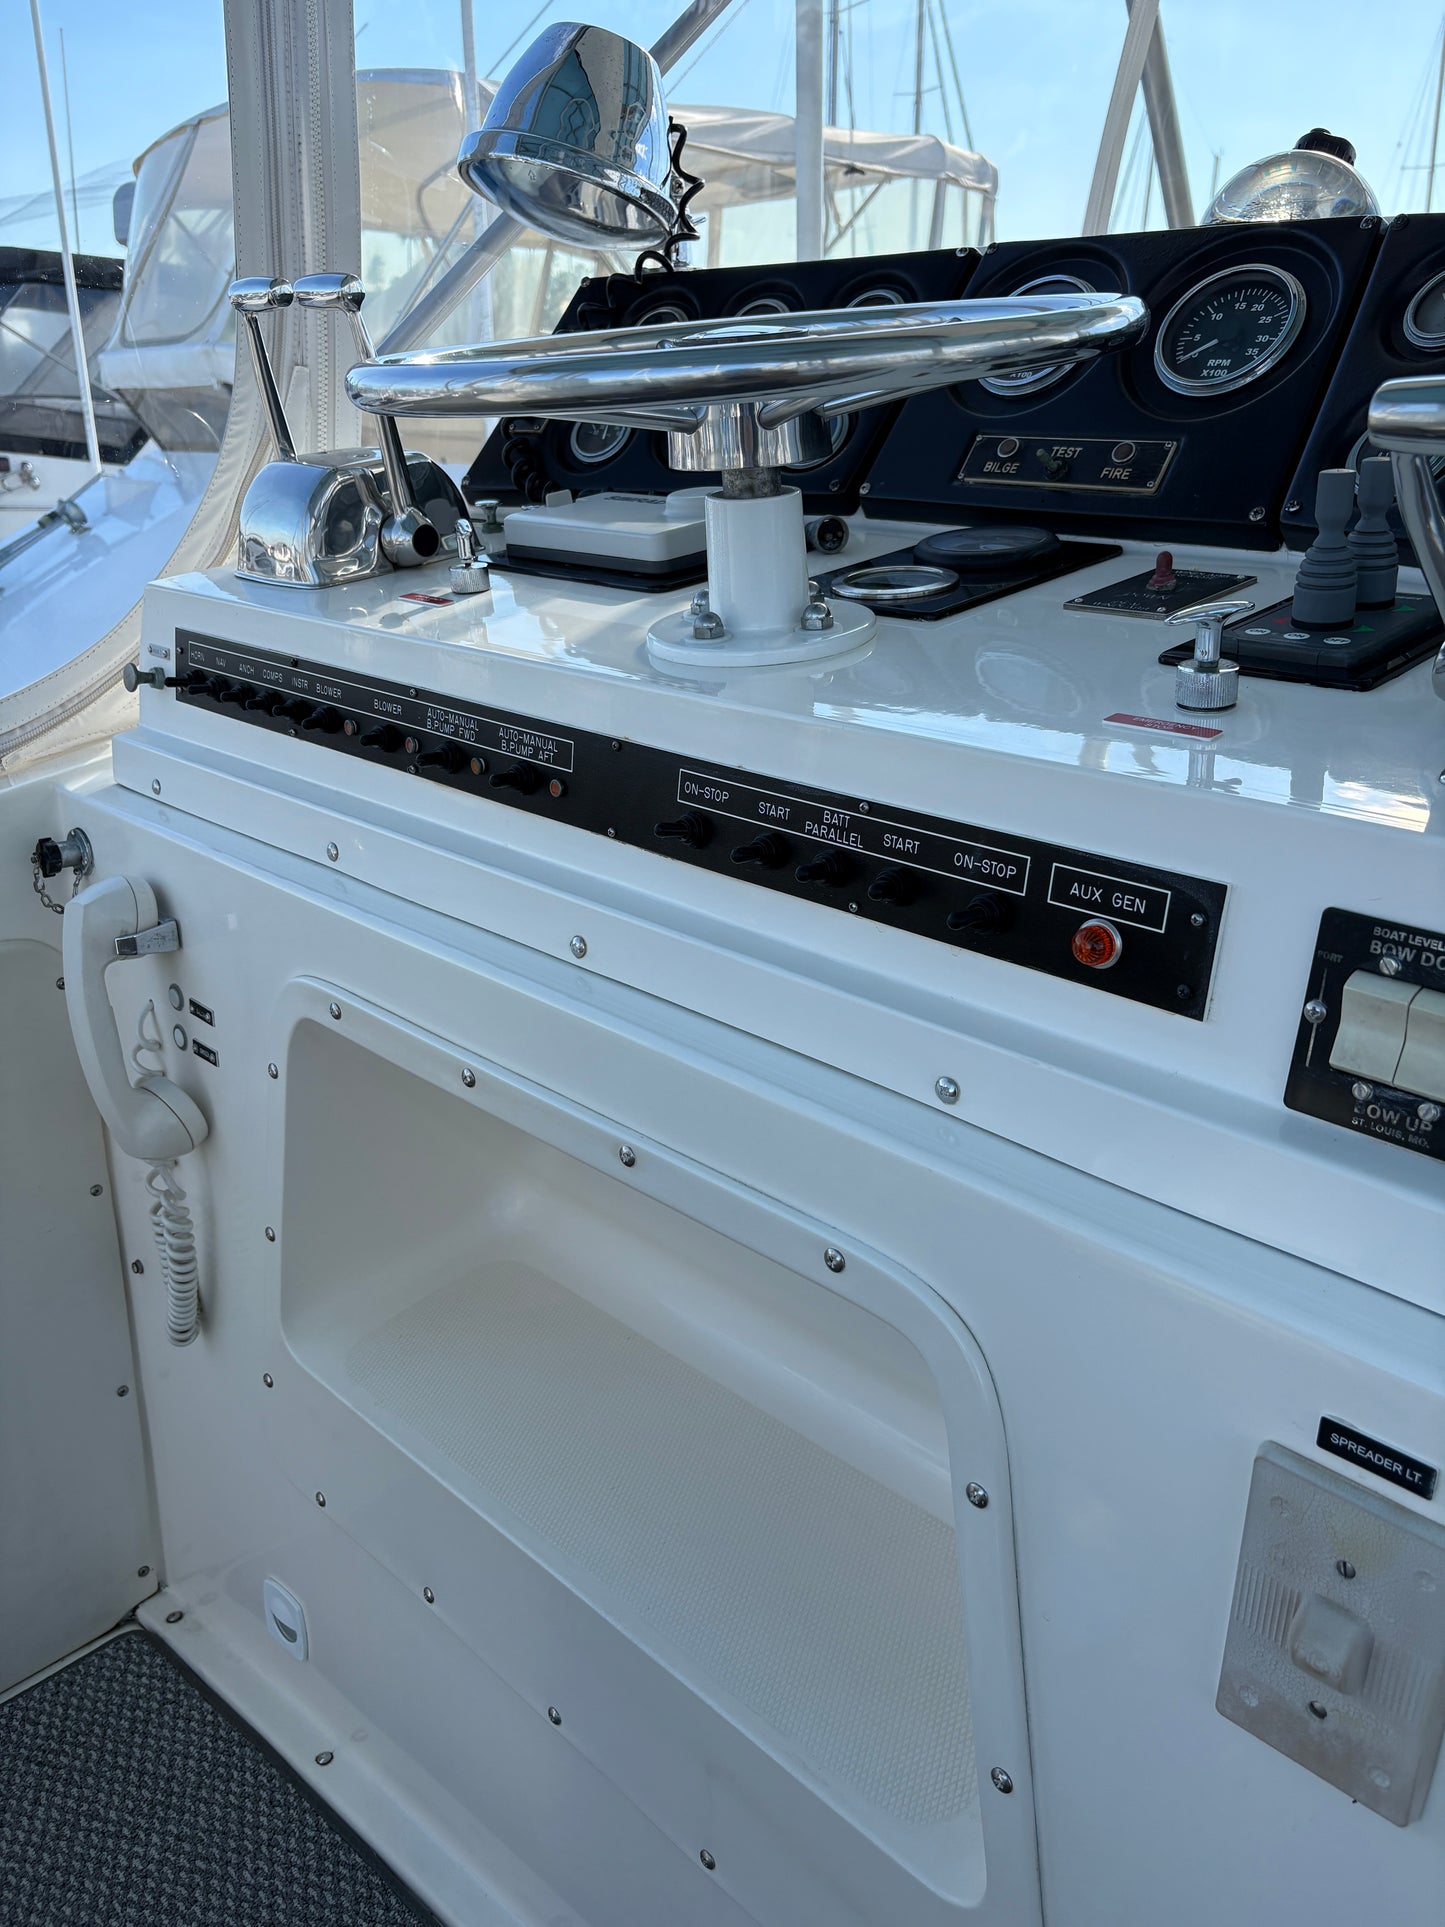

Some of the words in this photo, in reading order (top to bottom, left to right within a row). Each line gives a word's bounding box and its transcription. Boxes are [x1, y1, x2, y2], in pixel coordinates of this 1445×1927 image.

[1234, 302, 1247, 310] 15
[1250, 303, 1265, 311] 20
[1211, 313, 1223, 321] 10
[1258, 316, 1273, 324] 25
[1193, 334, 1201, 342] 5
[1255, 335, 1269, 343] 30
[1245, 348, 1259, 356] 35
[1207, 359, 1231, 367] RPM
[1200, 369, 1228, 377] X100
[1050, 446, 1084, 459] TEST
[982, 461, 1020, 474] BILGE
[1100, 467, 1134, 481] FIRE
[190, 651, 205, 662] HORN
[215, 656, 227, 668] NAV
[238, 663, 255, 676] ANCH
[262, 669, 283, 683] COMPS
[291, 677, 309, 690] INSTR
[316, 683, 342, 699] BLOWER
[374, 699, 402, 715] BLOWER
[427, 707, 479, 732] AUTO-MANUAL
[426, 721, 455, 735] B.PUMP
[458, 728, 476, 742] FWD
[498, 727, 558, 753] AUTO-MANUAL
[501, 742, 534, 758] B.PUMP
[537, 750, 554, 764] AFT
[684, 781, 730, 804] ON-STOP
[758, 801, 791, 821] START
[823, 810, 850, 829] BATT
[805, 821, 864, 848] PARALLEL
[883, 833, 921, 855] START
[953, 852, 1017, 880] ON-STOP
[1069, 882, 1103, 903] AUX
[1111, 892, 1147, 914] GEN
[1373, 926, 1407, 942] BOAT
[1408, 934, 1445, 952] LEVEL
[1317, 950, 1344, 964] PORT
[1369, 940, 1417, 963] BOW
[1352, 1116, 1368, 1128] ST.
[1408, 1134, 1430, 1149] MO.
[1405, 1116, 1433, 1134] UP
[1330, 1432, 1403, 1476] SPREADER
[1405, 1468, 1423, 1485] LT.
